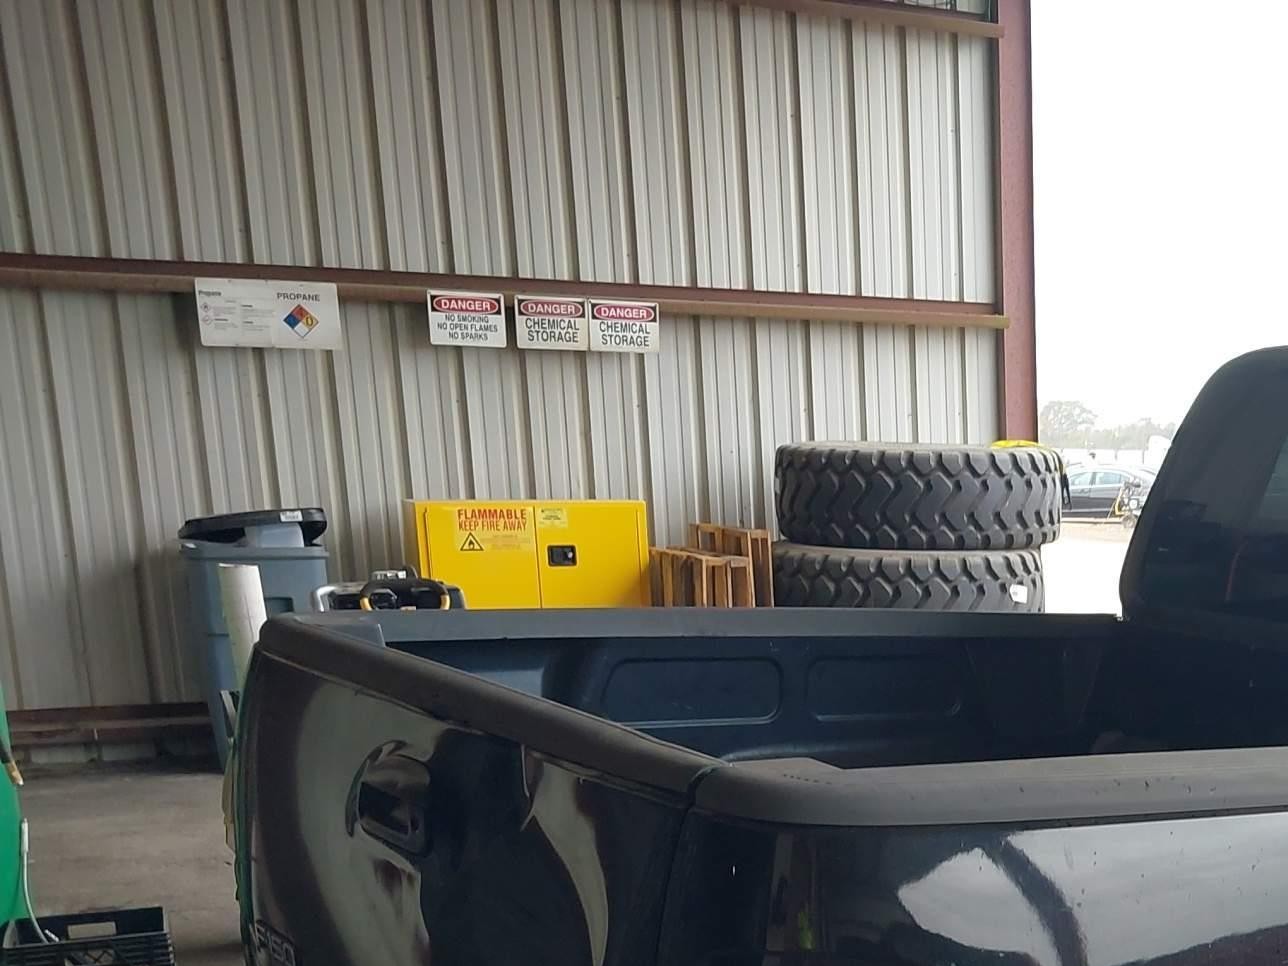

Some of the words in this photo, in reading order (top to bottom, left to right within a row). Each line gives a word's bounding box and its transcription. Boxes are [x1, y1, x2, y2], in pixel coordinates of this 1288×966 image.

[276, 292, 321, 302] PROPANE
[440, 299, 491, 311] DANGER
[527, 303, 576, 315] DANGER
[445, 314, 455, 322] NO
[457, 314, 490, 323] SMOKING
[600, 307, 647, 319] DANGER
[437, 322, 448, 330] NO
[449, 322, 469, 331] OPEN
[470, 324, 498, 333] FLAMES
[525, 317, 580, 331] CHEMICAL
[599, 321, 651, 334] CHEMICAL
[448, 331, 459, 340] NO
[460, 332, 488, 341] SPARKS
[527, 330, 579, 343] STORAGE
[601, 334, 650, 347] STORAGE
[457, 508, 527, 520] FLAMMABLE
[458, 520, 479, 531] KEEP
[481, 520, 501, 531] FIRE
[503, 520, 527, 531] AWAY
